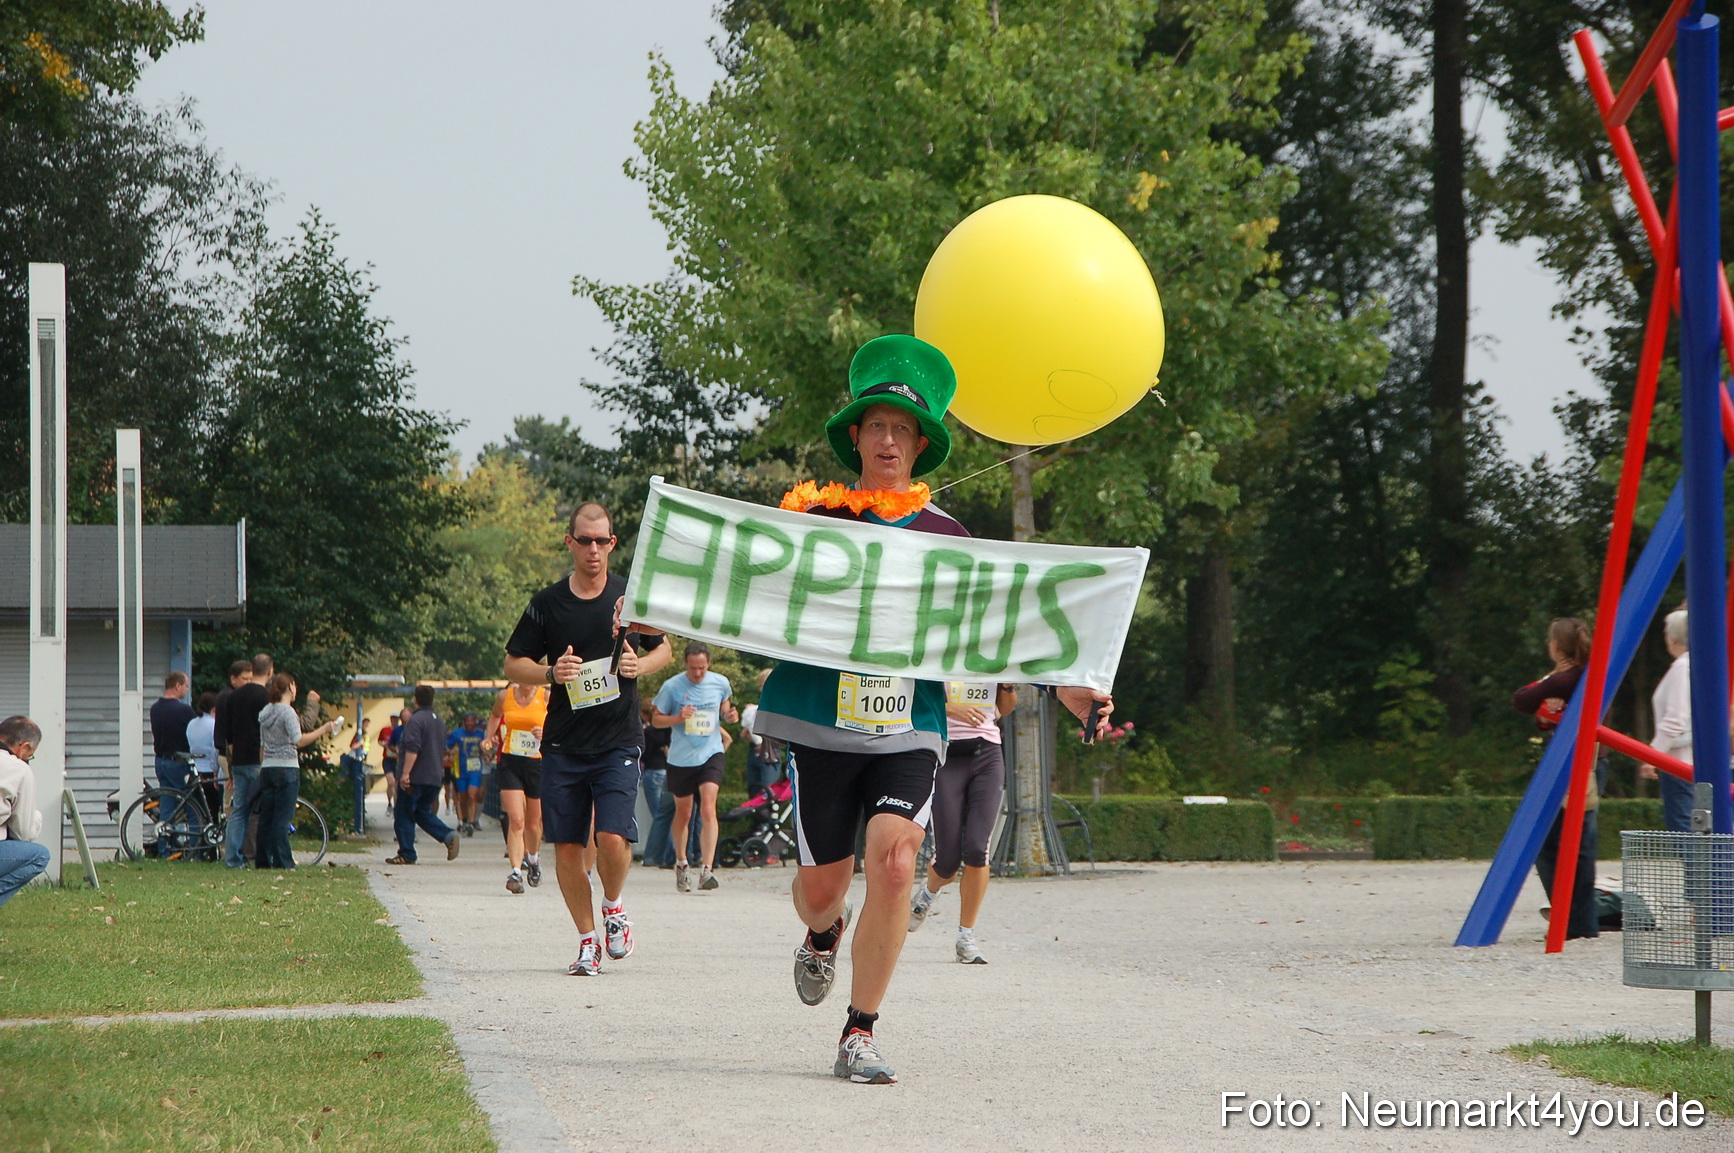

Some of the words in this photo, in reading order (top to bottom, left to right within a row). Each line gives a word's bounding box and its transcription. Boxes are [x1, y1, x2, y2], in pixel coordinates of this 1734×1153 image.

[635, 496, 1107, 675] APPLAUS
[583, 675, 608, 692] 851
[860, 676, 891, 688] Bernd
[841, 690, 847, 700] C
[967, 688, 989, 700] 928
[860, 695, 906, 713] 1000
[696, 720, 711, 728] 669
[521, 740, 536, 749] 593
[885, 797, 914, 810] asics
